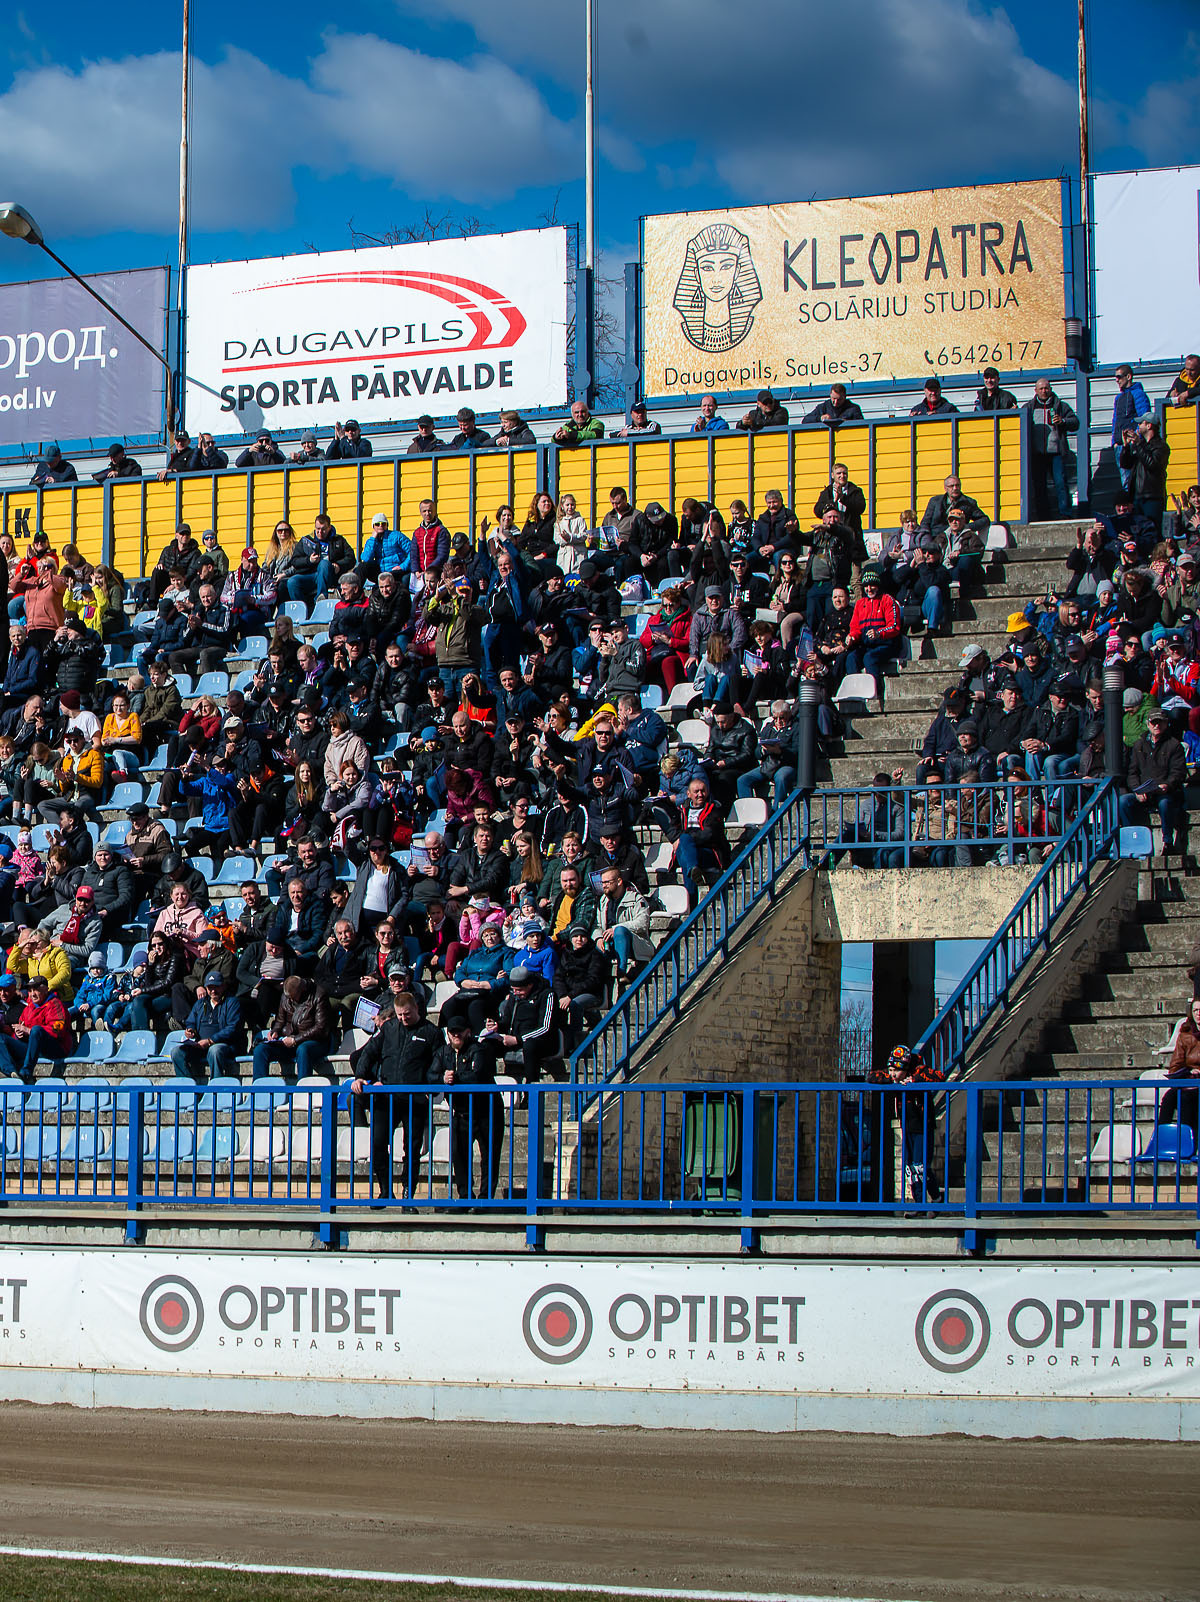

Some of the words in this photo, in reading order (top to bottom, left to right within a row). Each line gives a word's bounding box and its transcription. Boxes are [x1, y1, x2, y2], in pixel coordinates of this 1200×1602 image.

[783, 219, 1033, 293] KLEOPATRA
[798, 296, 908, 324] SOLĀRIJU
[923, 287, 1019, 314] STUDIJA
[224, 320, 464, 361] DAUGAVPILS
[936, 340, 1044, 367] 65426177
[220, 376, 340, 412] SPORTA
[351, 360, 513, 401] PĀRVALDE
[664, 358, 779, 388] Daugavpils,
[786, 352, 883, 378] Saules-37
[15, 508, 31, 539] K
[1156, 1001, 1163, 1013] 4
[1127, 1055, 1133, 1066] 3
[219, 1285, 401, 1335] OPTIBET
[608, 1293, 806, 1344] OPTIBET
[219, 1336, 318, 1350] SPORTA
[337, 1336, 402, 1352] BĀRS
[608, 1346, 716, 1361] SPORTA
[736, 1346, 806, 1362] BĀRS
[1006, 1354, 1121, 1368] SPORTA
[1143, 1353, 1195, 1367] BĀR
